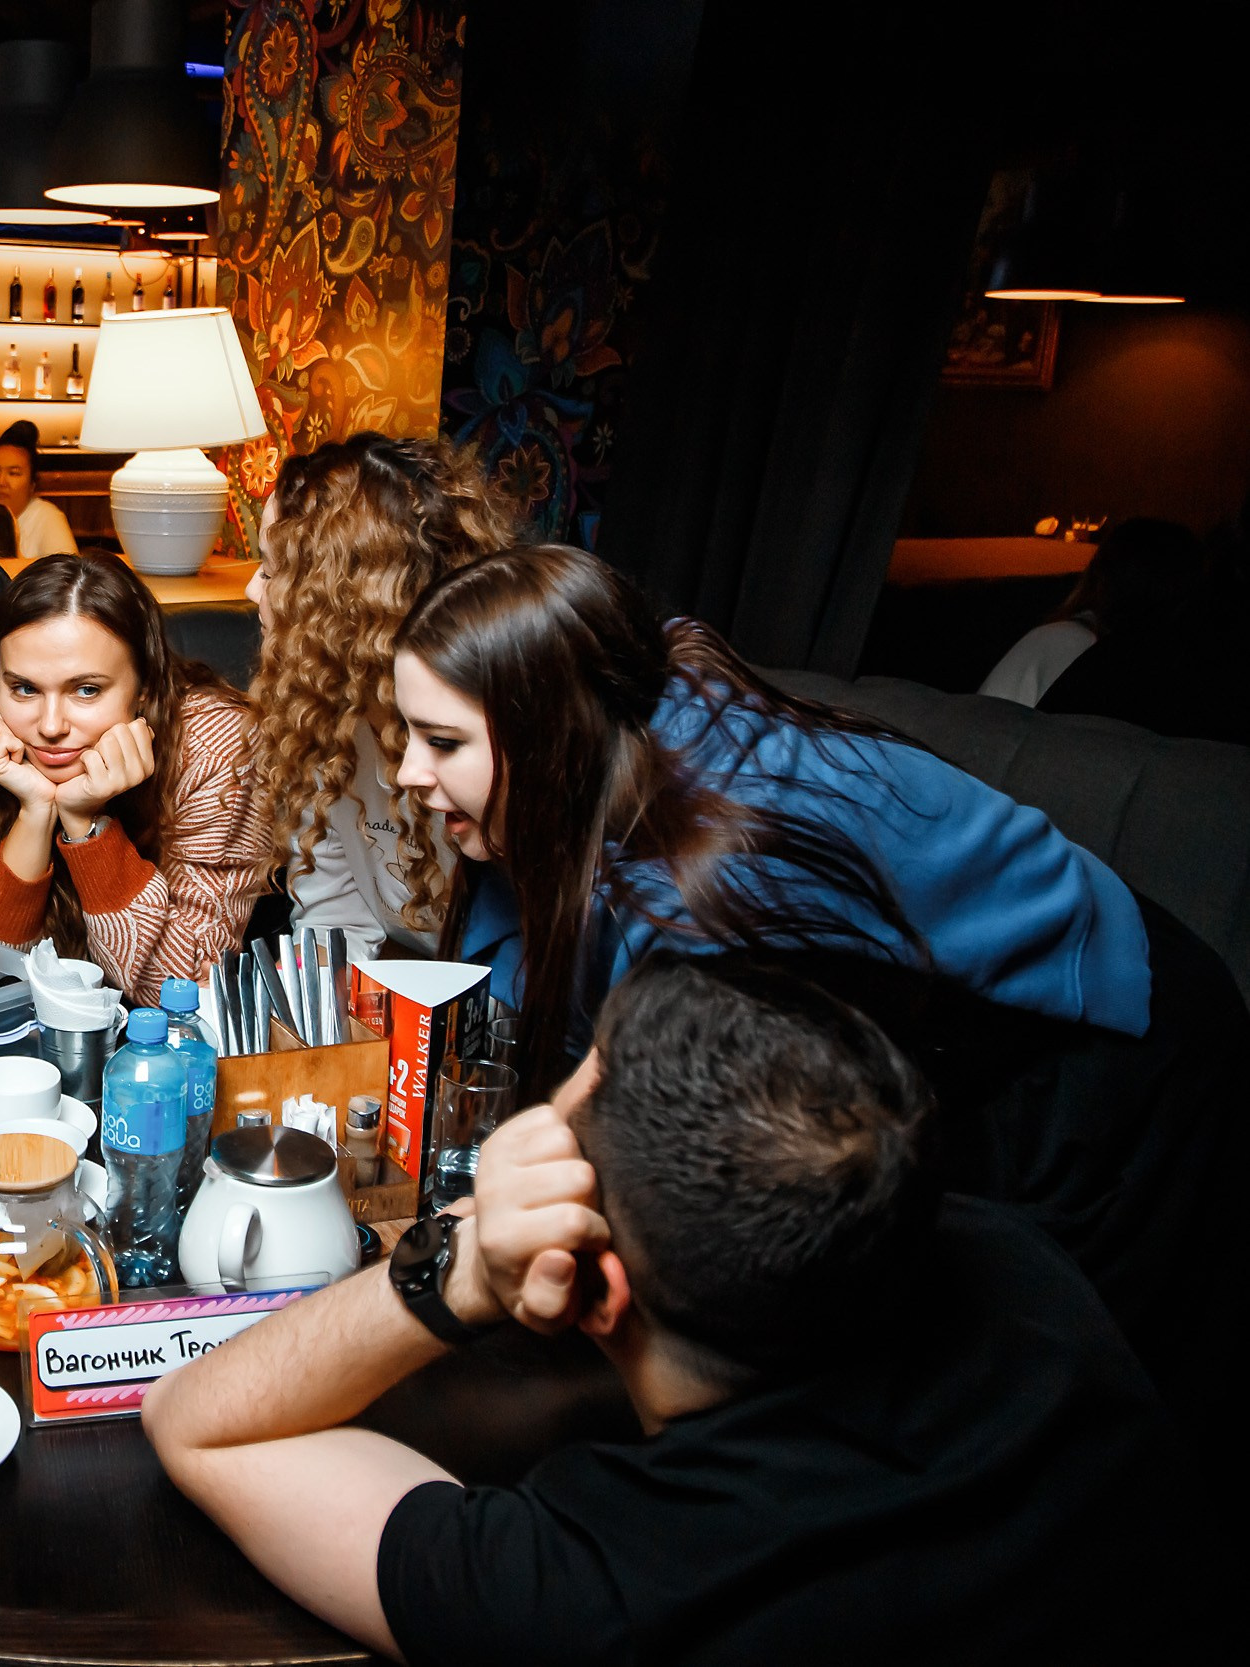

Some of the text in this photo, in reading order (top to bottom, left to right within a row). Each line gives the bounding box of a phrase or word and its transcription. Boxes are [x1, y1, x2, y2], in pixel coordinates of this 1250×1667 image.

[412, 1014, 431, 1098] WALKER
[194, 1081, 214, 1097] bo
[44, 1330, 229, 1375] Вагончик Тро
